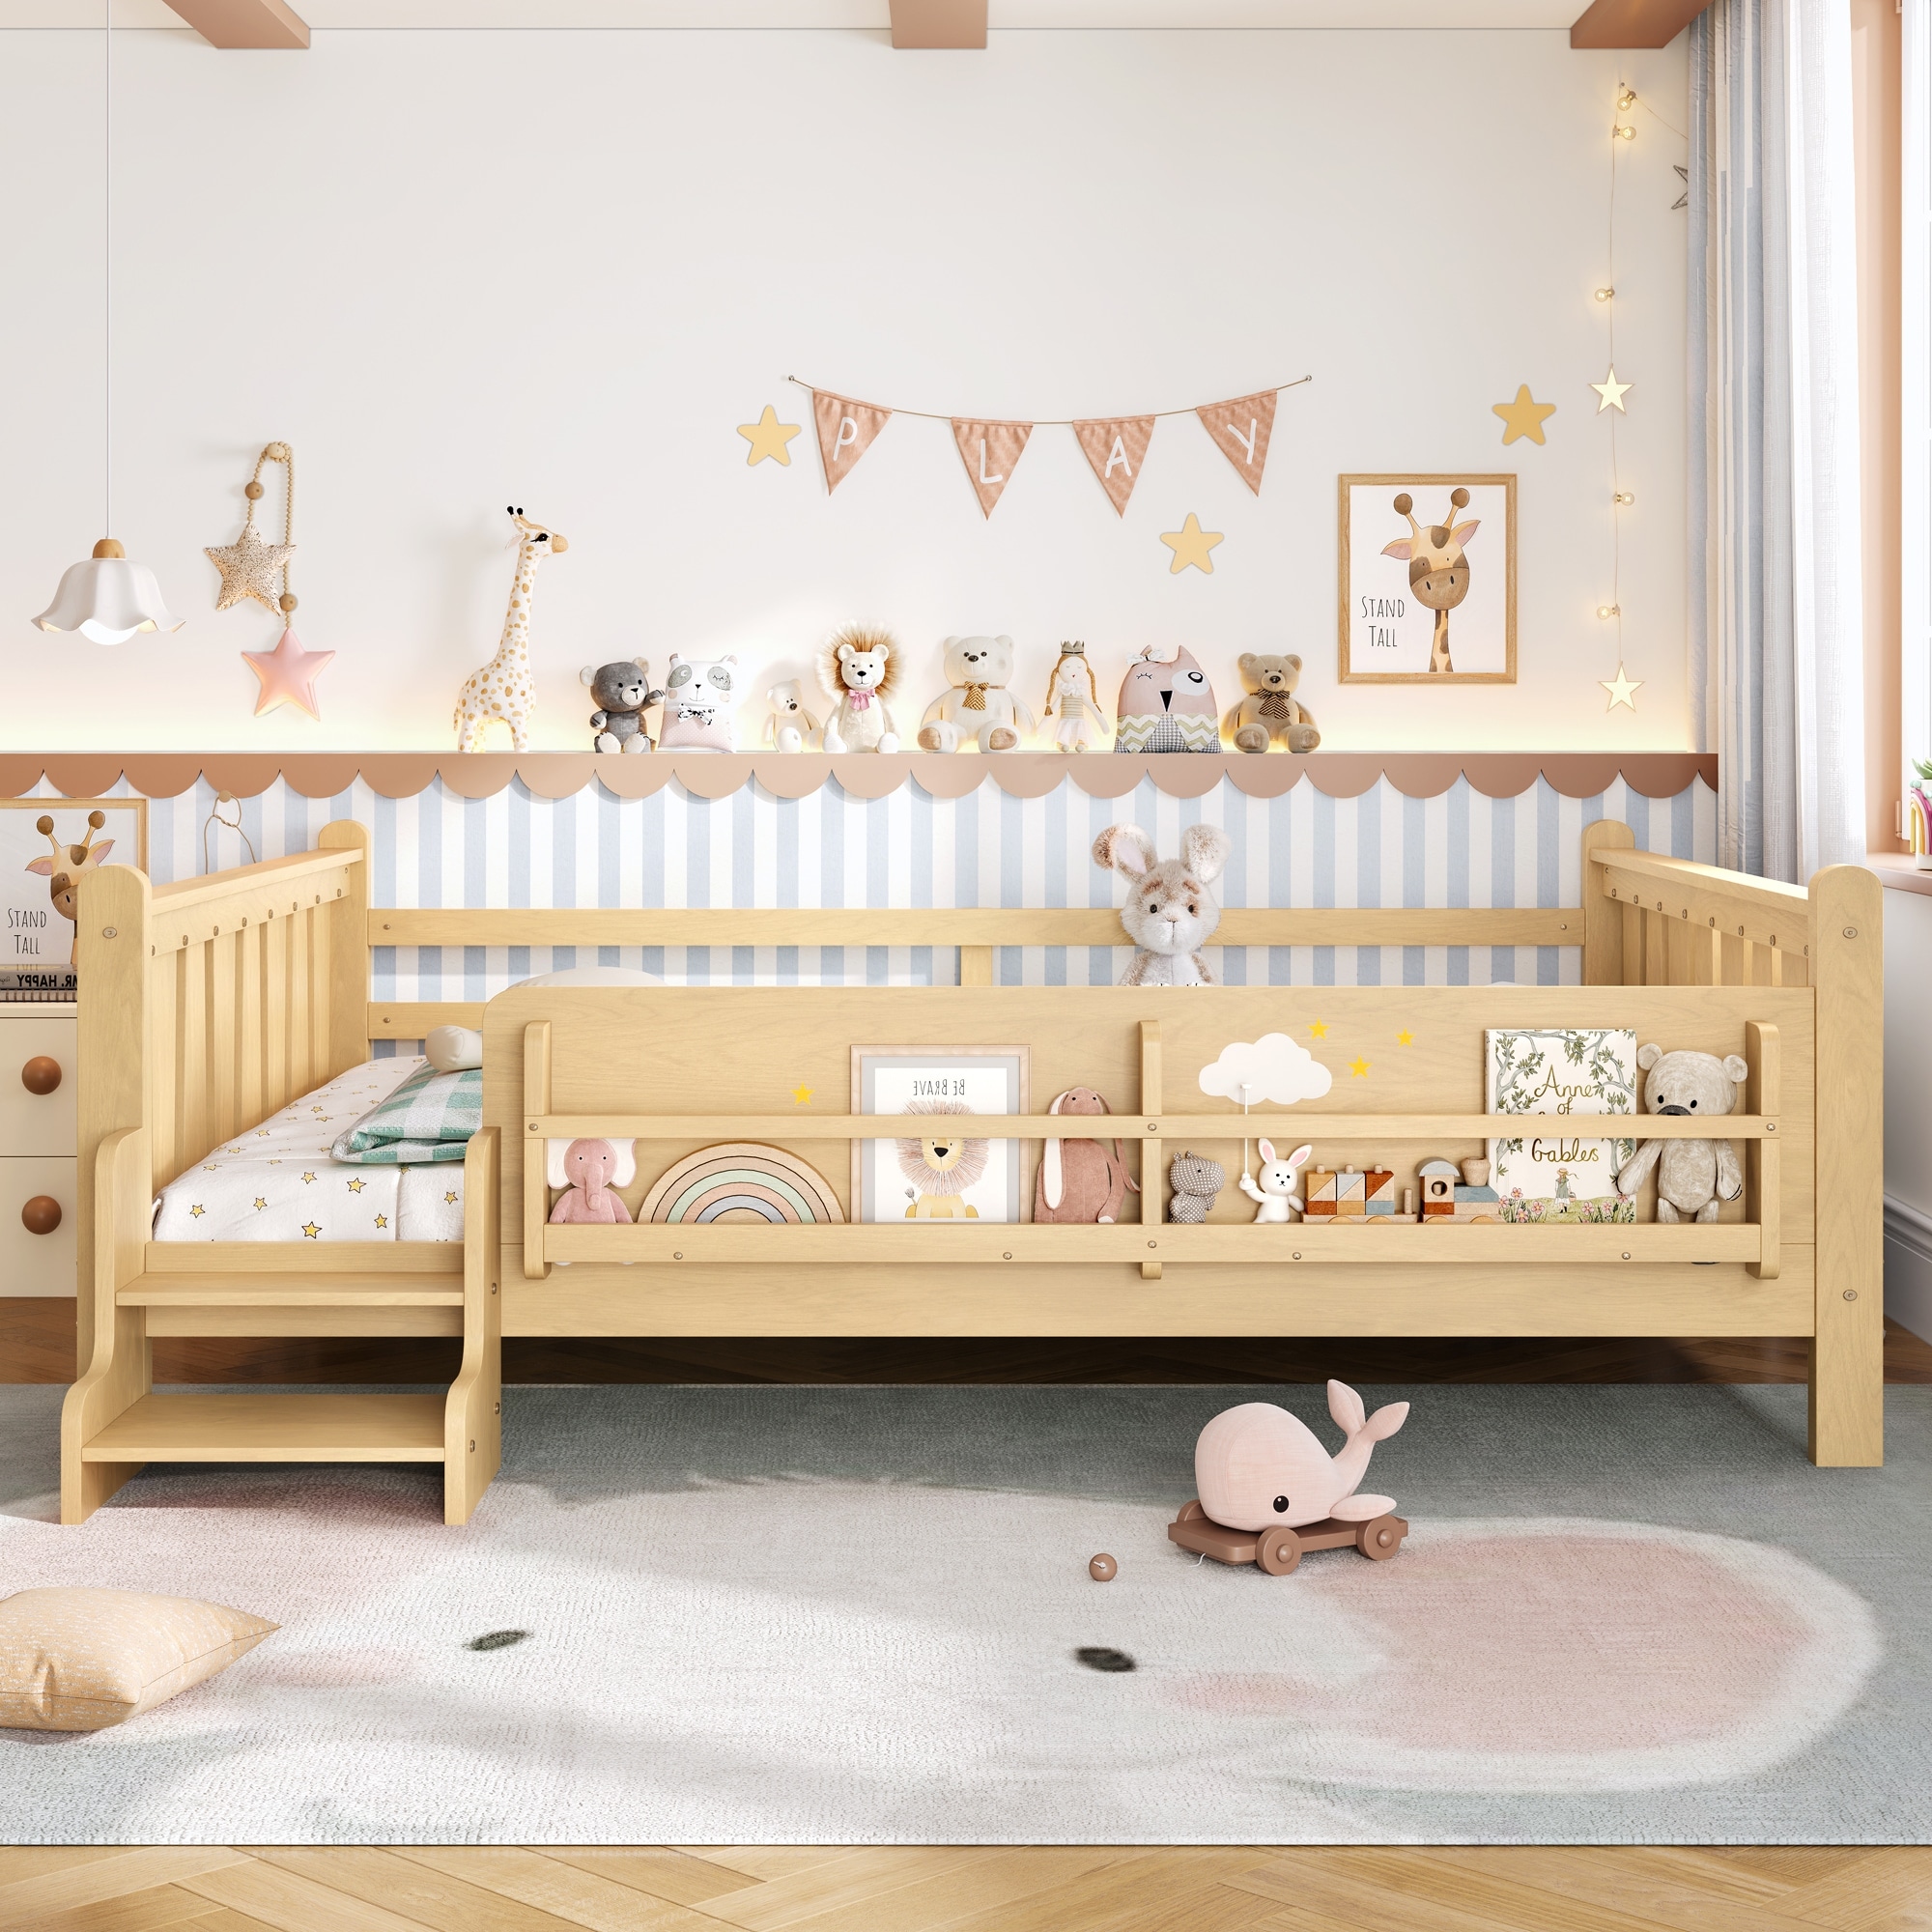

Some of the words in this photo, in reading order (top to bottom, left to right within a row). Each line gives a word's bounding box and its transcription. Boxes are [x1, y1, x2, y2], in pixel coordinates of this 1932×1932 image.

[833, 416, 1258, 483] PLAY
[1361, 595, 1406, 618] STAND
[1368, 625, 1398, 647] TALL
[7, 907, 47, 928] STAND
[14, 934, 41, 954] TALL
[1534, 1064, 1595, 1098] Anne
[1556, 1096, 1574, 1115] of
[1531, 1138, 1600, 1163] Gables
